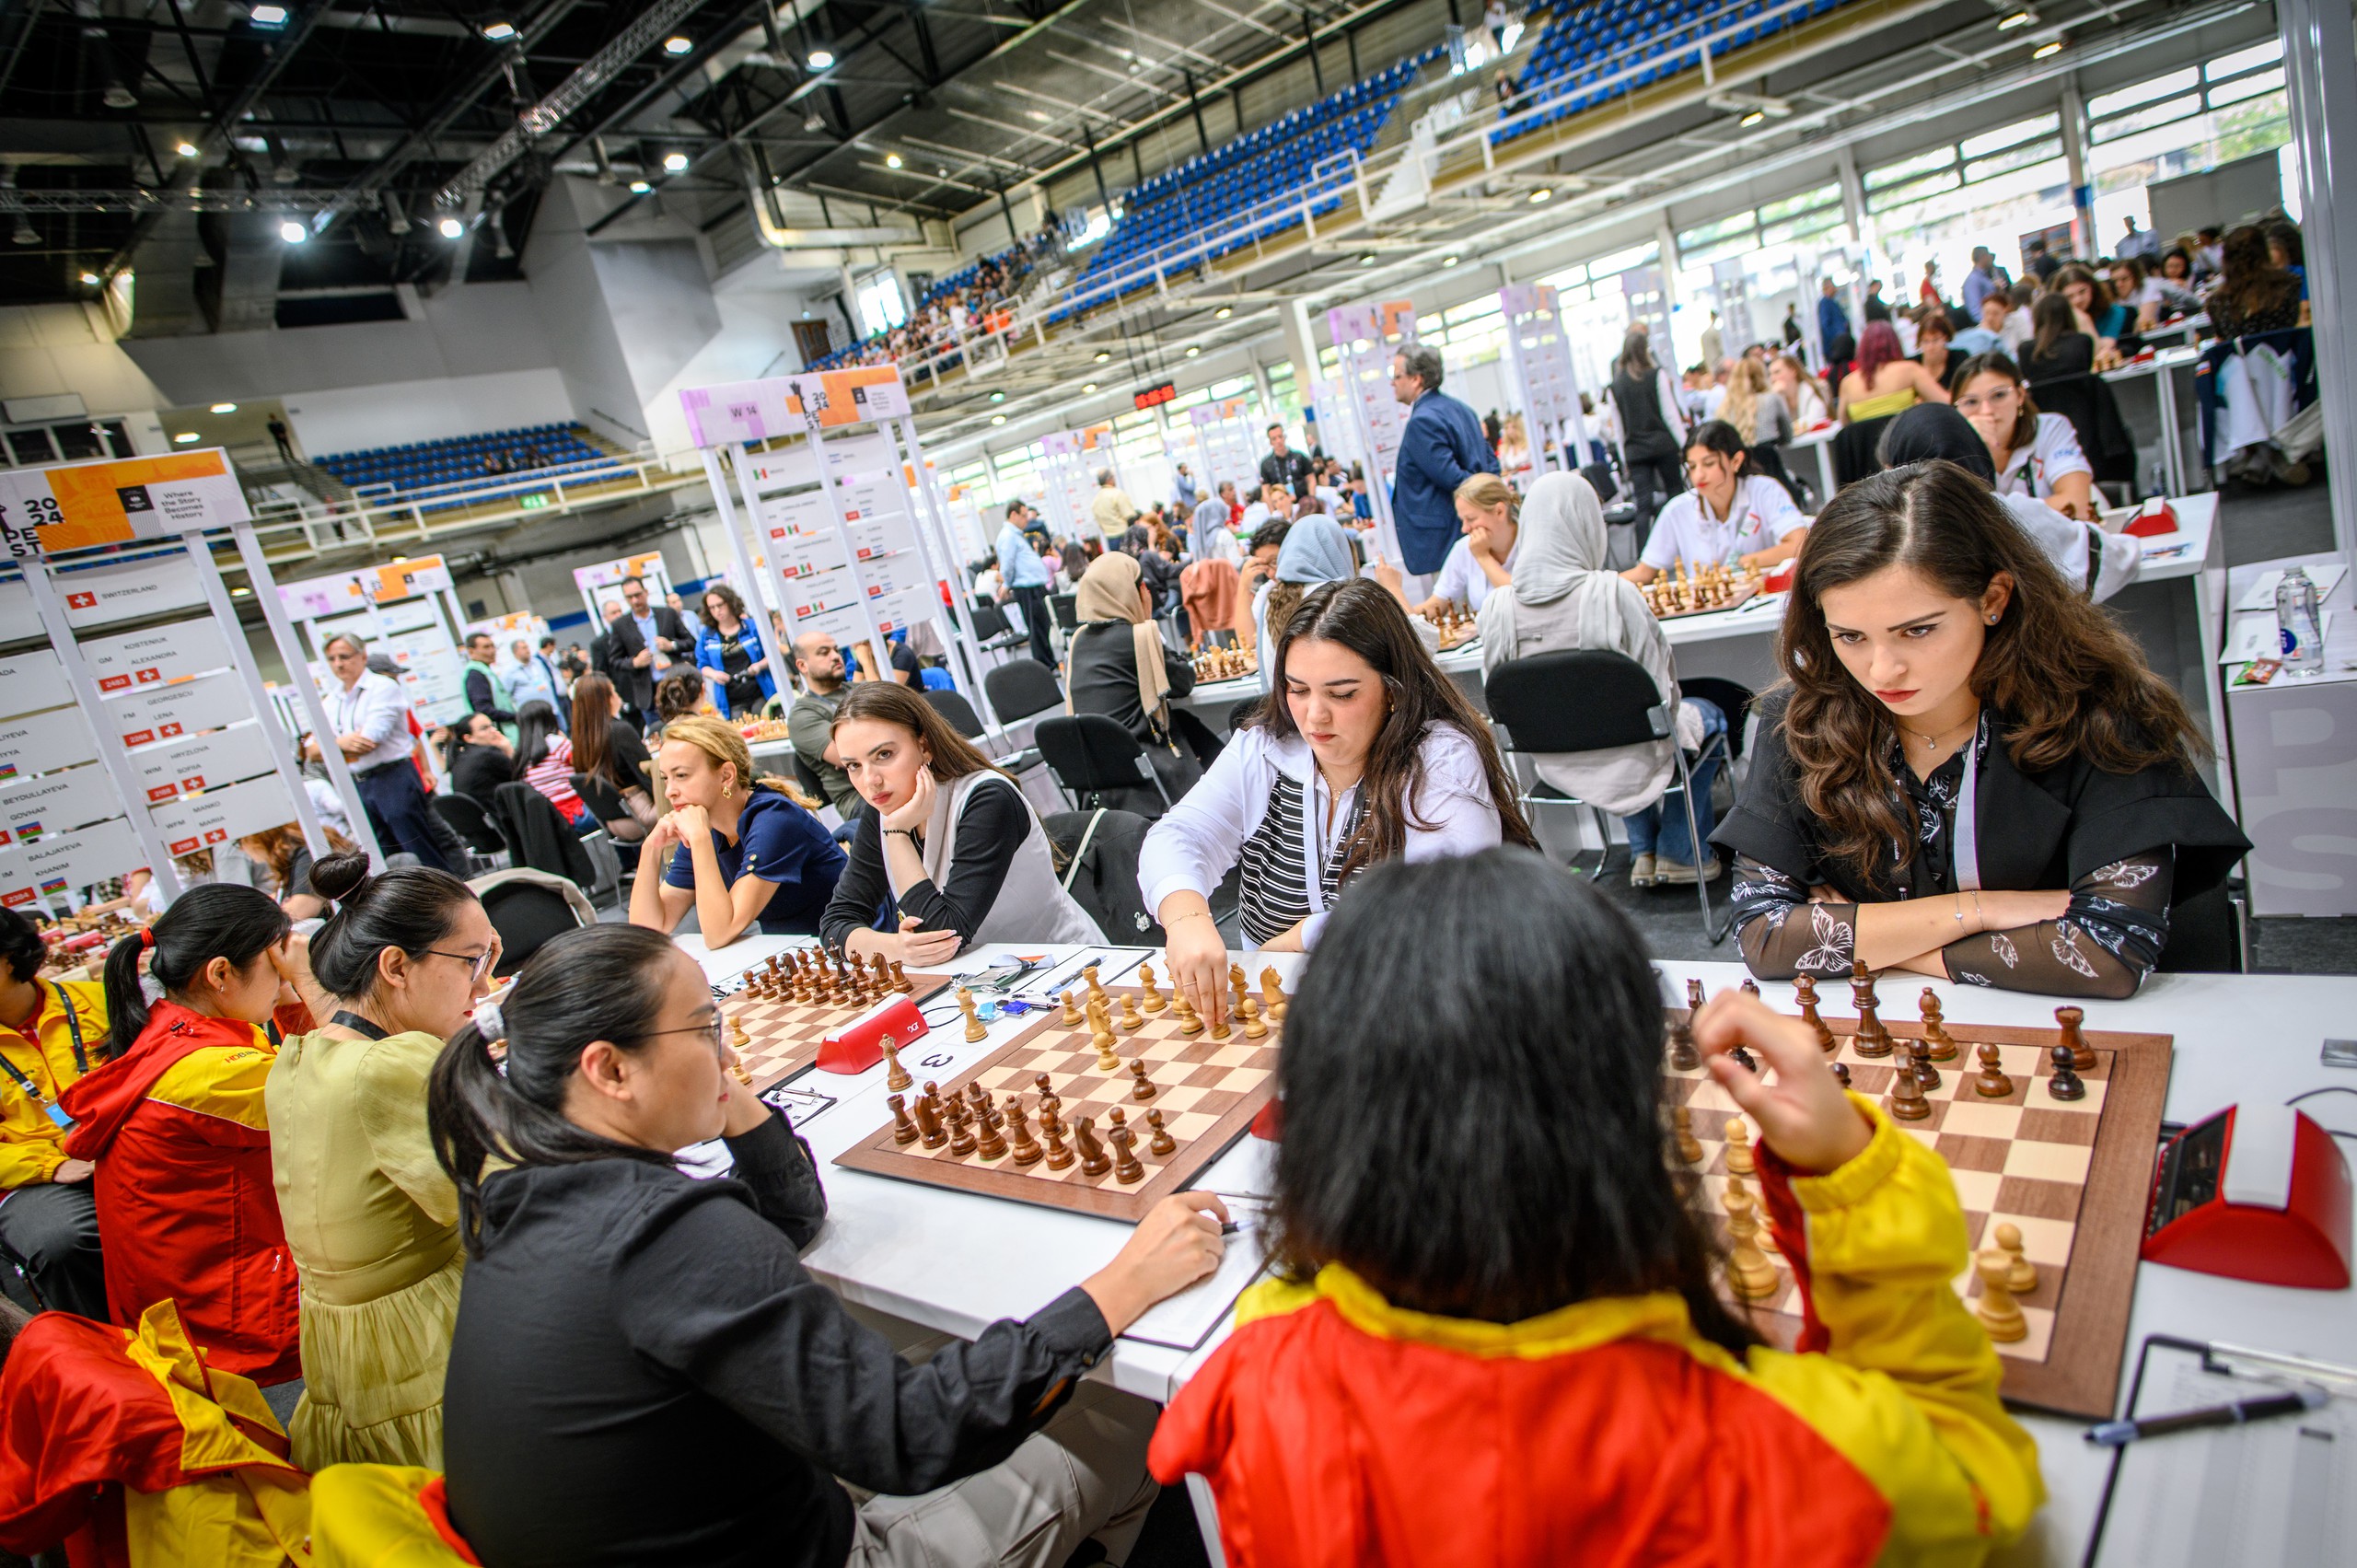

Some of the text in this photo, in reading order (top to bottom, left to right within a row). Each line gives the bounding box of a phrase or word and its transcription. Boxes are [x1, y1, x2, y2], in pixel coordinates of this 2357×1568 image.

[813, 392, 827, 401] 20
[731, 406, 758, 417] W 14
[816, 401, 830, 411] 24
[807, 421, 820, 430] ST
[163, 491, 193, 499] Where
[178, 497, 201, 505] Story
[24, 497, 57, 513] 20
[164, 505, 203, 514] Becomes
[29, 511, 64, 527] 24
[171, 512, 203, 520] History
[5, 528, 39, 543] PE
[9, 540, 41, 557] ST
[101, 585, 158, 599] SWITZERLAND
[124, 637, 168, 650] KOSTENIUK
[131, 651, 178, 665] ALEXANDRA
[147, 691, 194, 705] GEORGESCU
[153, 712, 175, 721] LENA
[170, 745, 210, 760] HRYZLOVA
[177, 763, 202, 774] SOFIIA
[3, 784, 69, 806] BEYDULLAYEVA
[192, 801, 221, 813] MANKO
[9, 806, 47, 821] GOVHAR
[199, 816, 226, 828] MARIIA
[28, 842, 83, 862] BALAJAYEVA
[1, 870, 14, 878] IM
[35, 863, 70, 877] KHANIM
